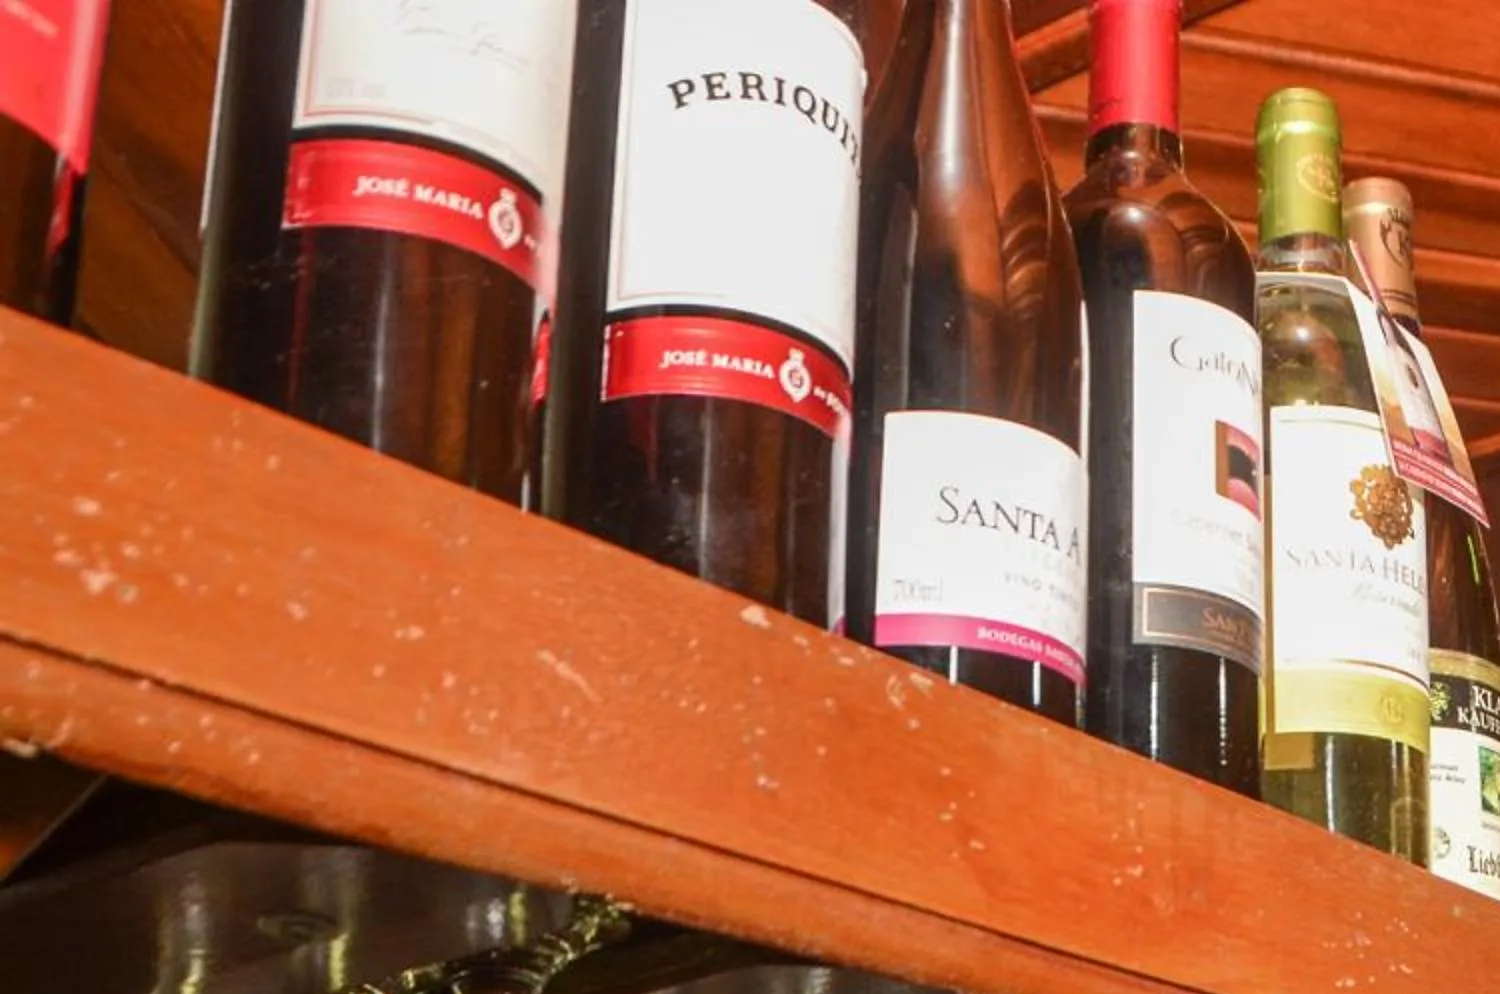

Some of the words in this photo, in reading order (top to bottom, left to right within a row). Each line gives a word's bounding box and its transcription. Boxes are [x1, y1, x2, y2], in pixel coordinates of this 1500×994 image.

[414, 184, 484, 220] MARIA
[712, 352, 776, 379] MARIA
[936, 485, 1061, 550] SANTA
[1286, 549, 1376, 575] SANTA
